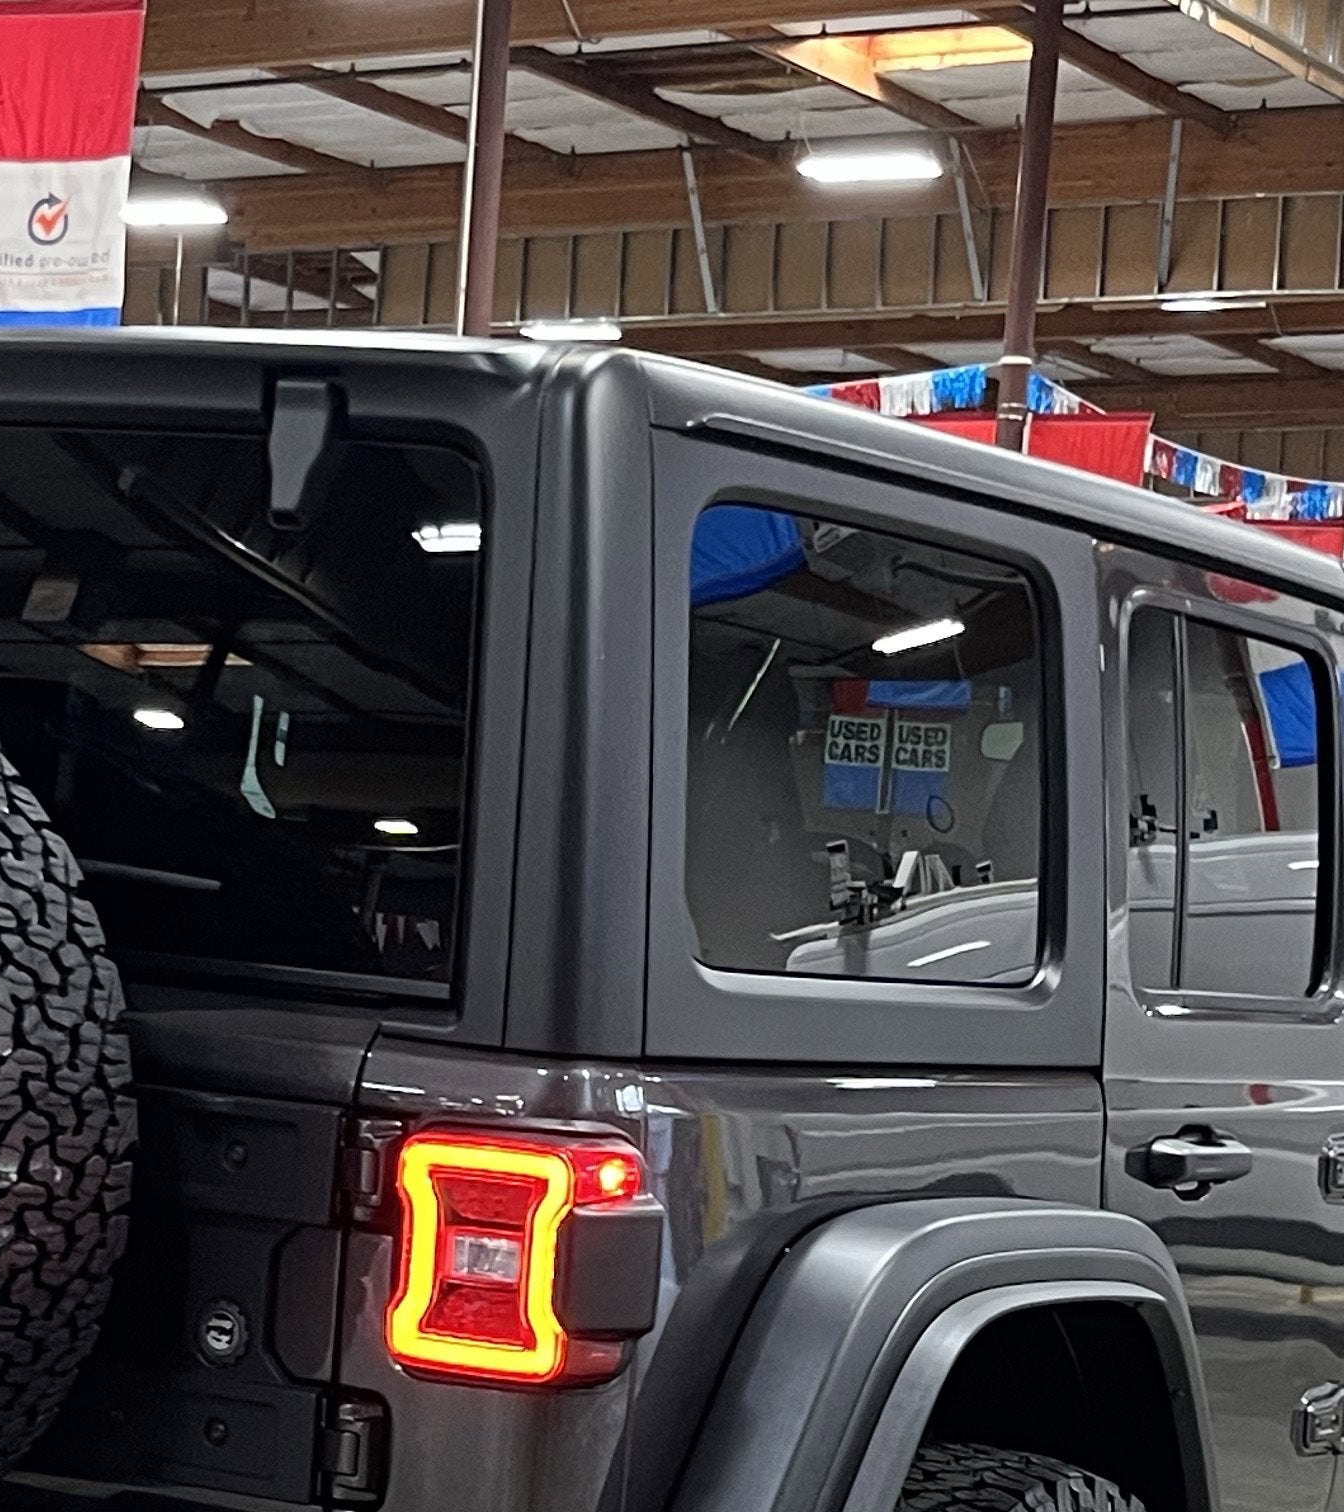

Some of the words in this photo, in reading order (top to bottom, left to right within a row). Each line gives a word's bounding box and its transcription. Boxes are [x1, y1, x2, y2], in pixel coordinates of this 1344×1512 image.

[830, 719, 882, 741] USED
[898, 724, 948, 747] USED
[827, 741, 880, 763] CARS
[895, 746, 947, 769] CARS
